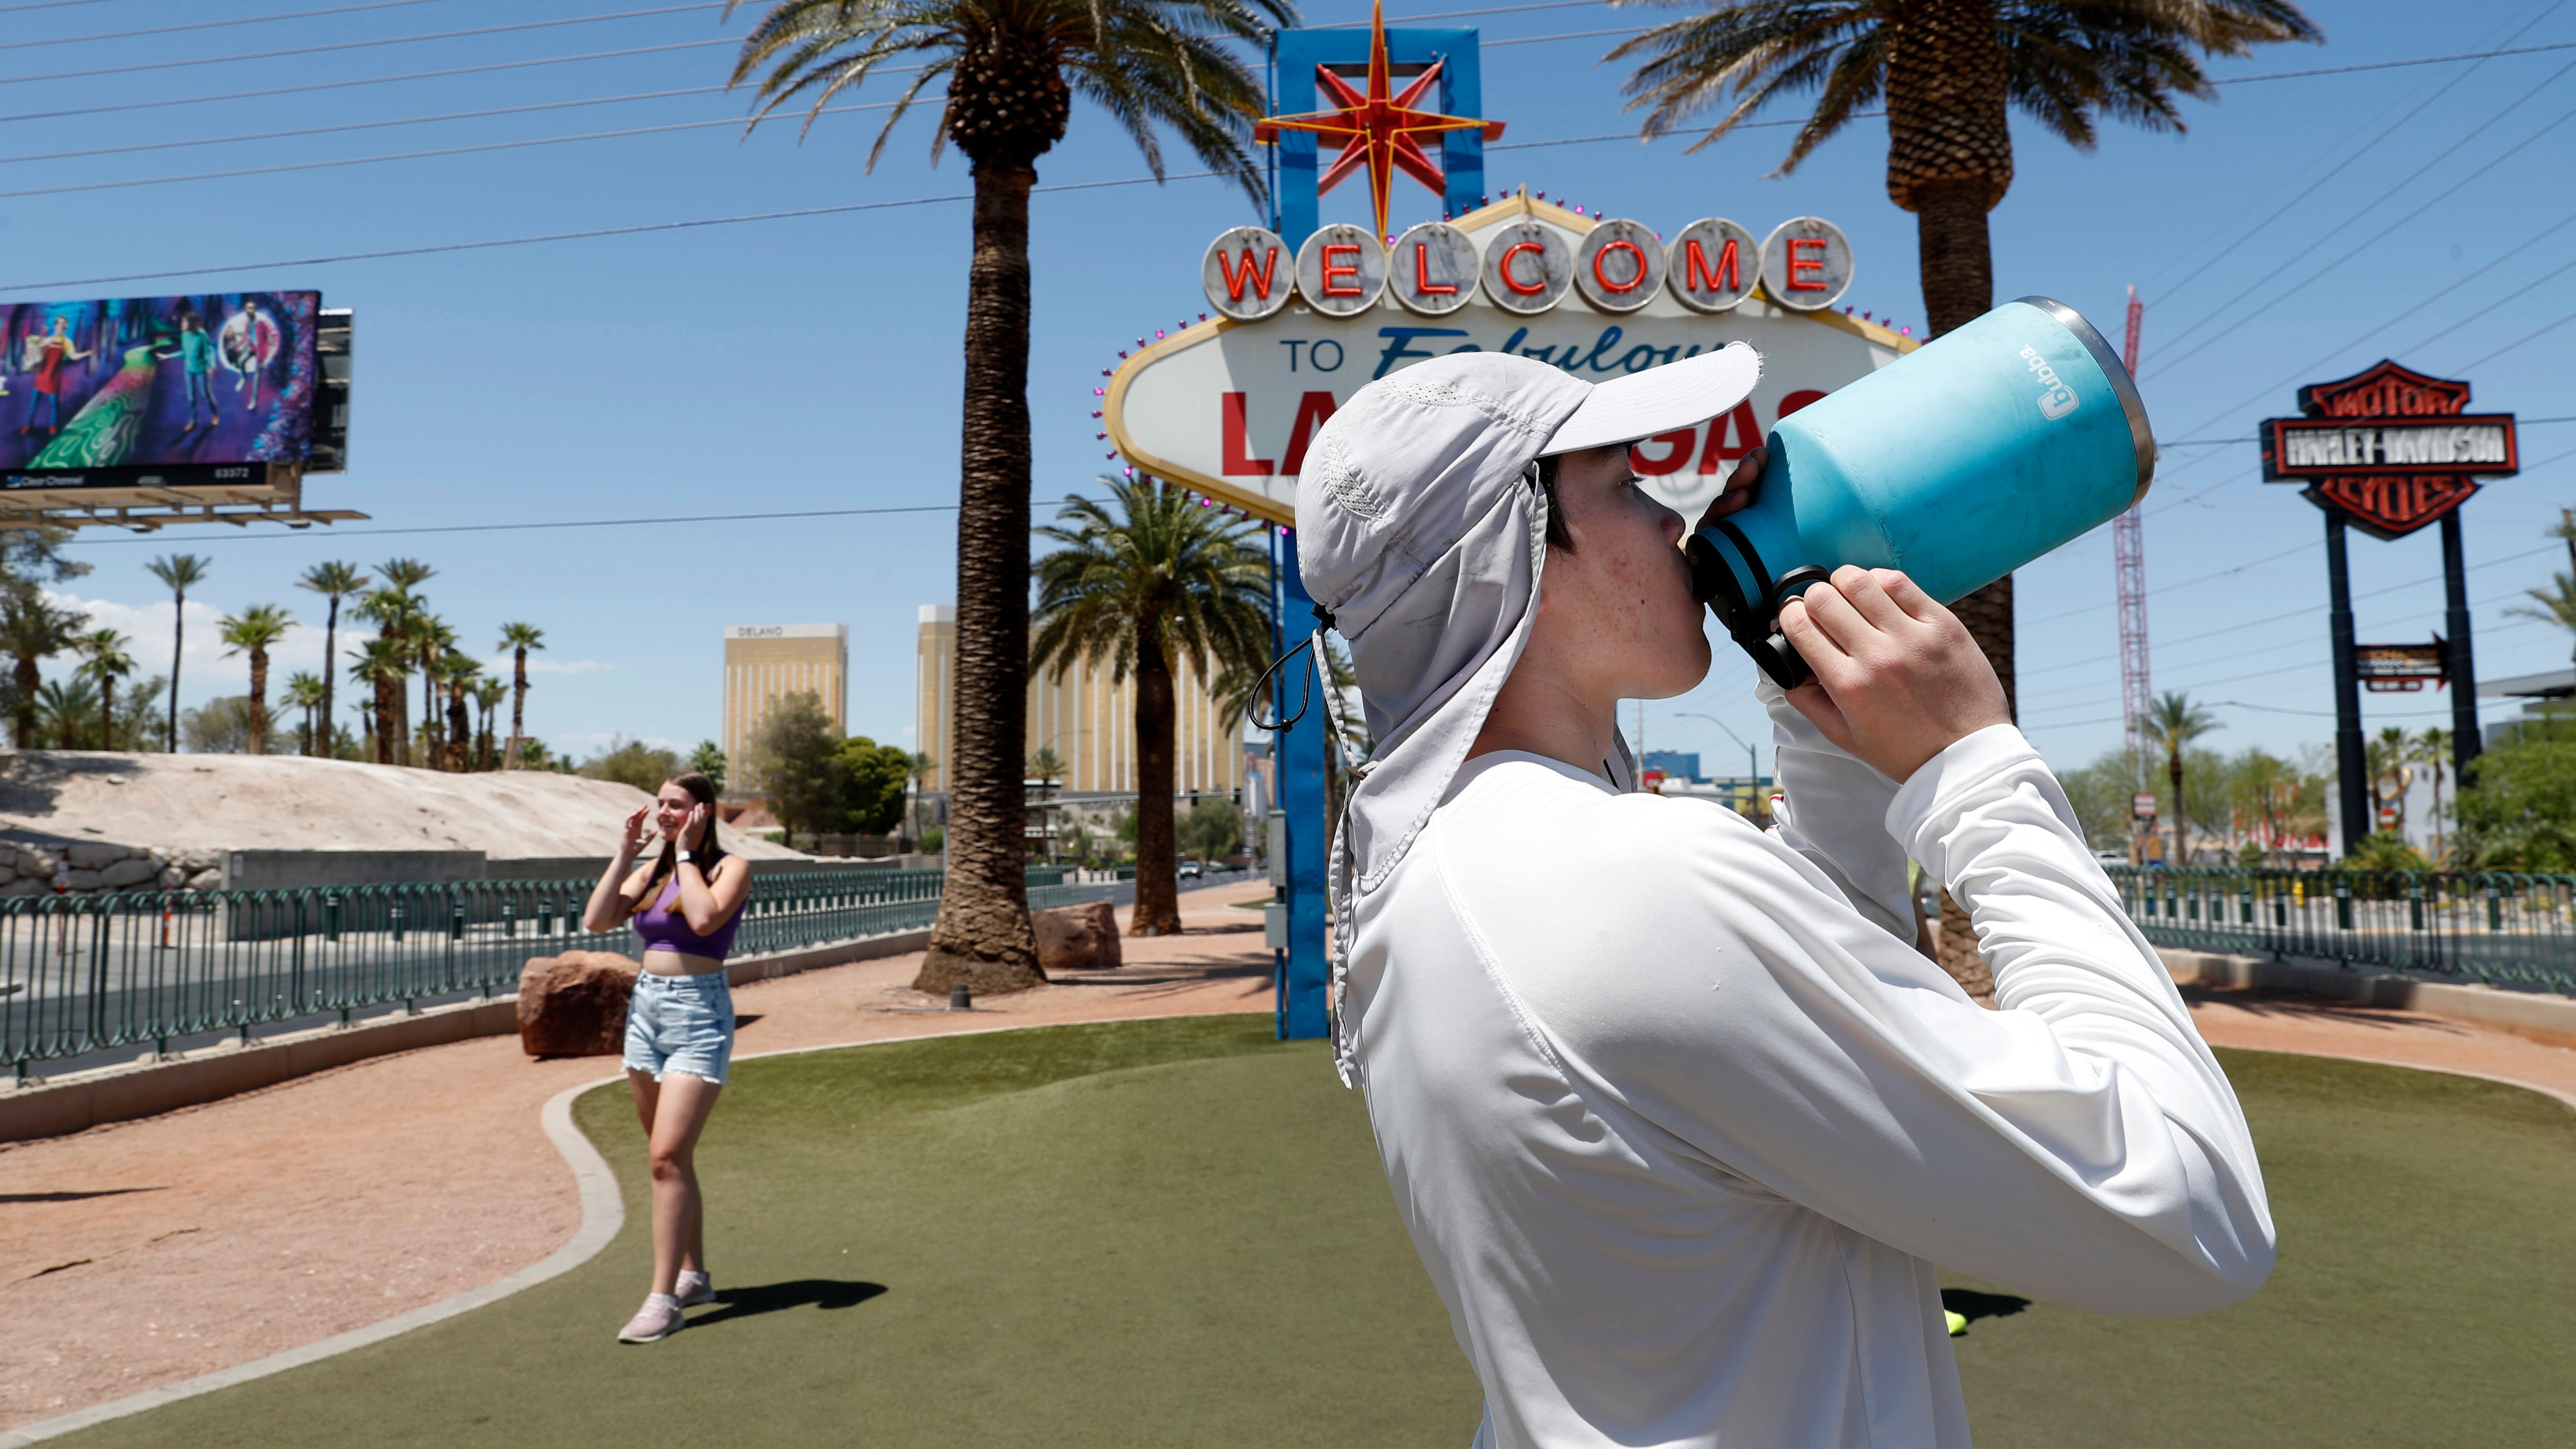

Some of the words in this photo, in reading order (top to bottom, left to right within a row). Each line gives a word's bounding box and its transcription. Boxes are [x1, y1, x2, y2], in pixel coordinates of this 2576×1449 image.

[1217, 239, 1828, 302] WELCOME
[1279, 340, 1344, 373] TO
[1372, 326, 1726, 380] Fbulou
[2331, 374, 2451, 416] MOTOR
[2285, 426, 2507, 466] HARLEY-DAVIDSON
[2337, 475, 2455, 521] CYCLES
[738, 627, 783, 636] DELANO
